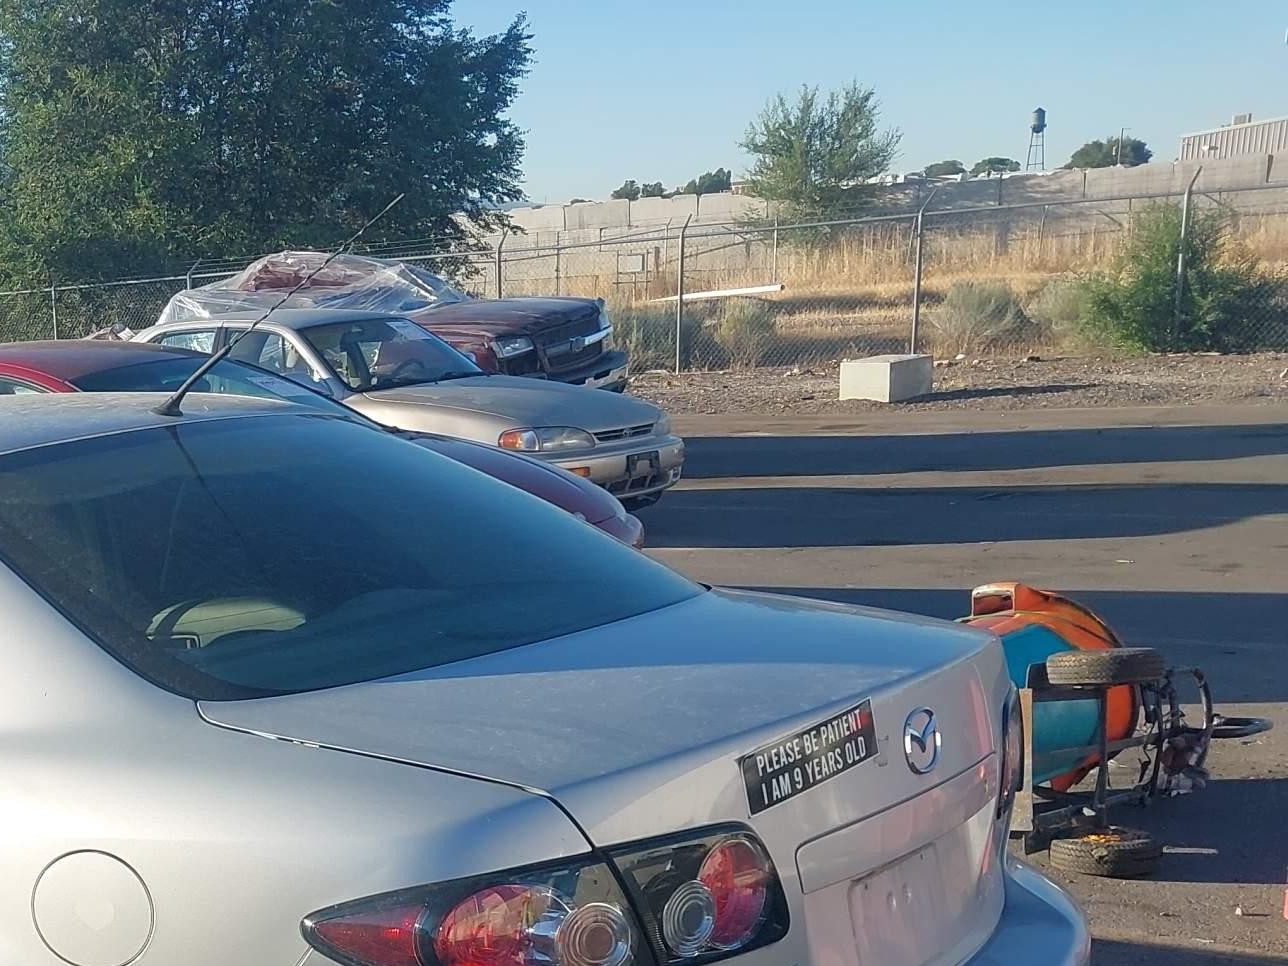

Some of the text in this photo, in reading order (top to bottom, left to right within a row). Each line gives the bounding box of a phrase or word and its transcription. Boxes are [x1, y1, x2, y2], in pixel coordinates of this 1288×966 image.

[756, 709, 862, 777] PLEASE BE PATIENT
[761, 736, 867, 805] I AM 9 YEARS OLD
